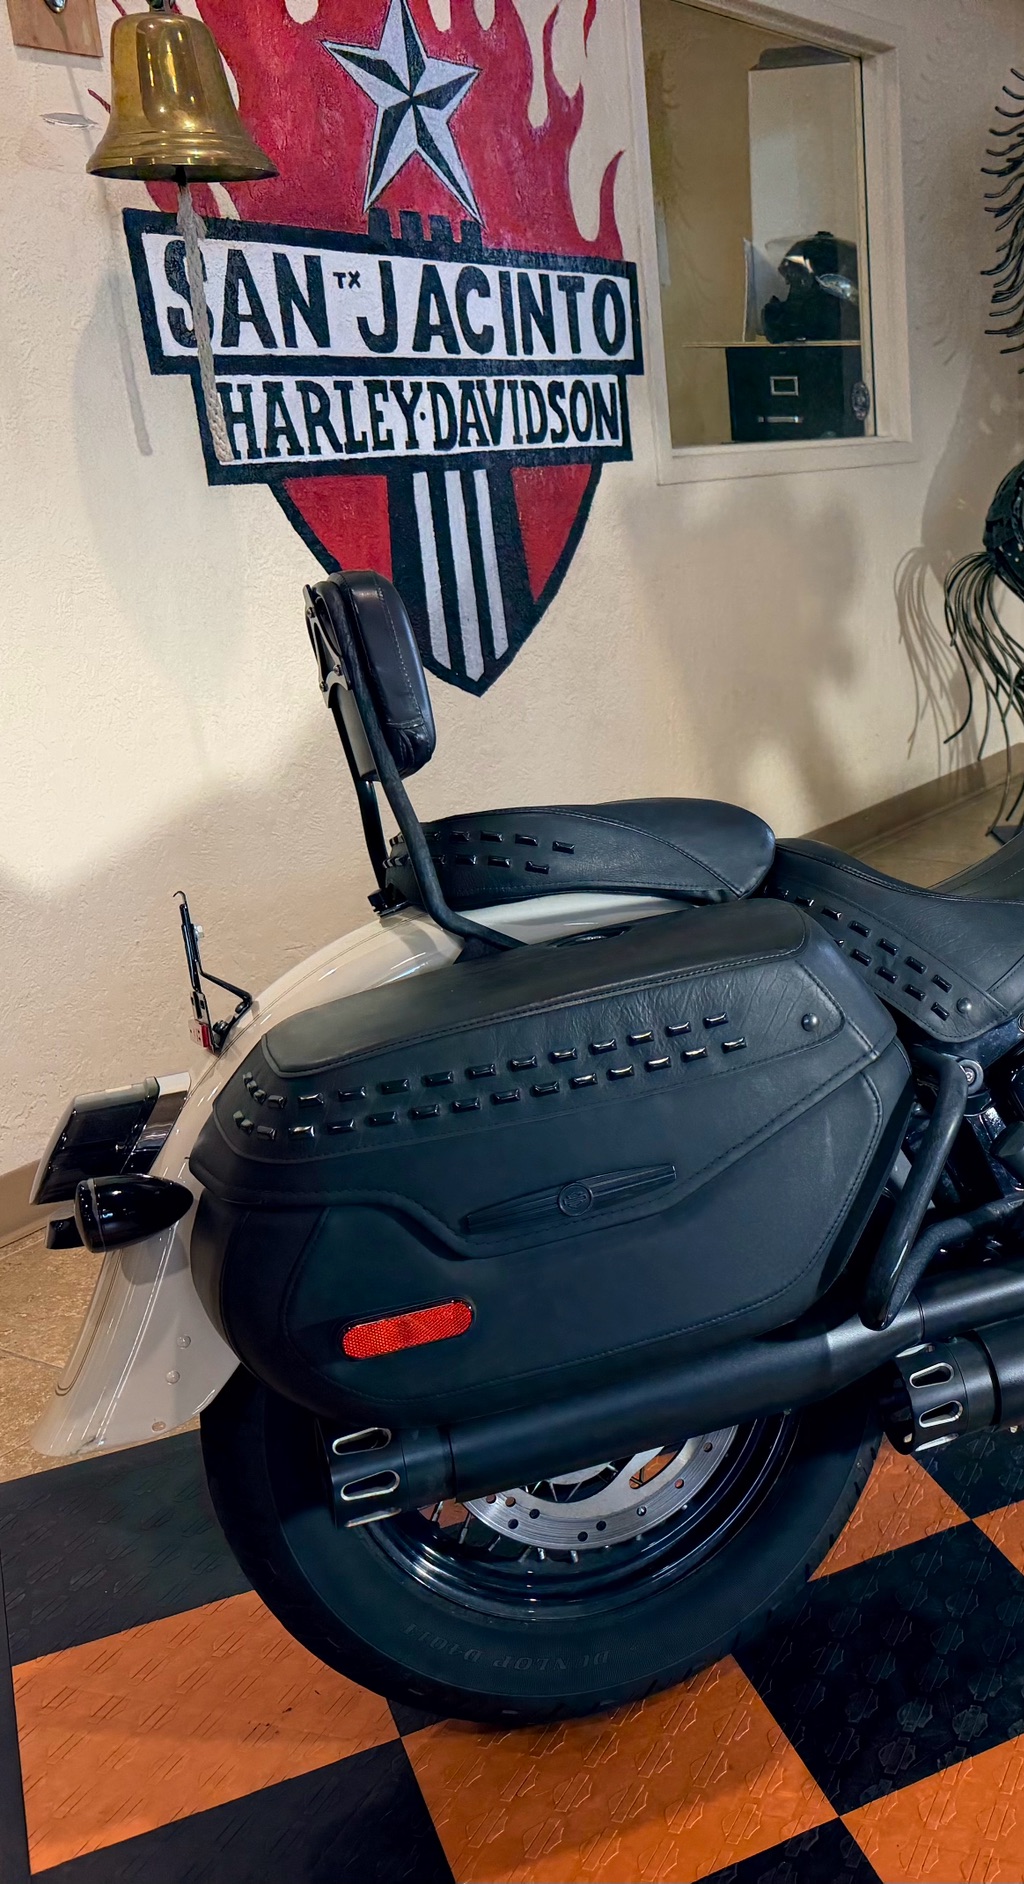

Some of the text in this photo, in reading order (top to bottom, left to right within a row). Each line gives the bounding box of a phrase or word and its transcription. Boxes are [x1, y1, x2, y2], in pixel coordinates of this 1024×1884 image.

[164, 239, 627, 356] SAN TX JACINTO
[492, 1650, 611, 1671] DUNLOP
